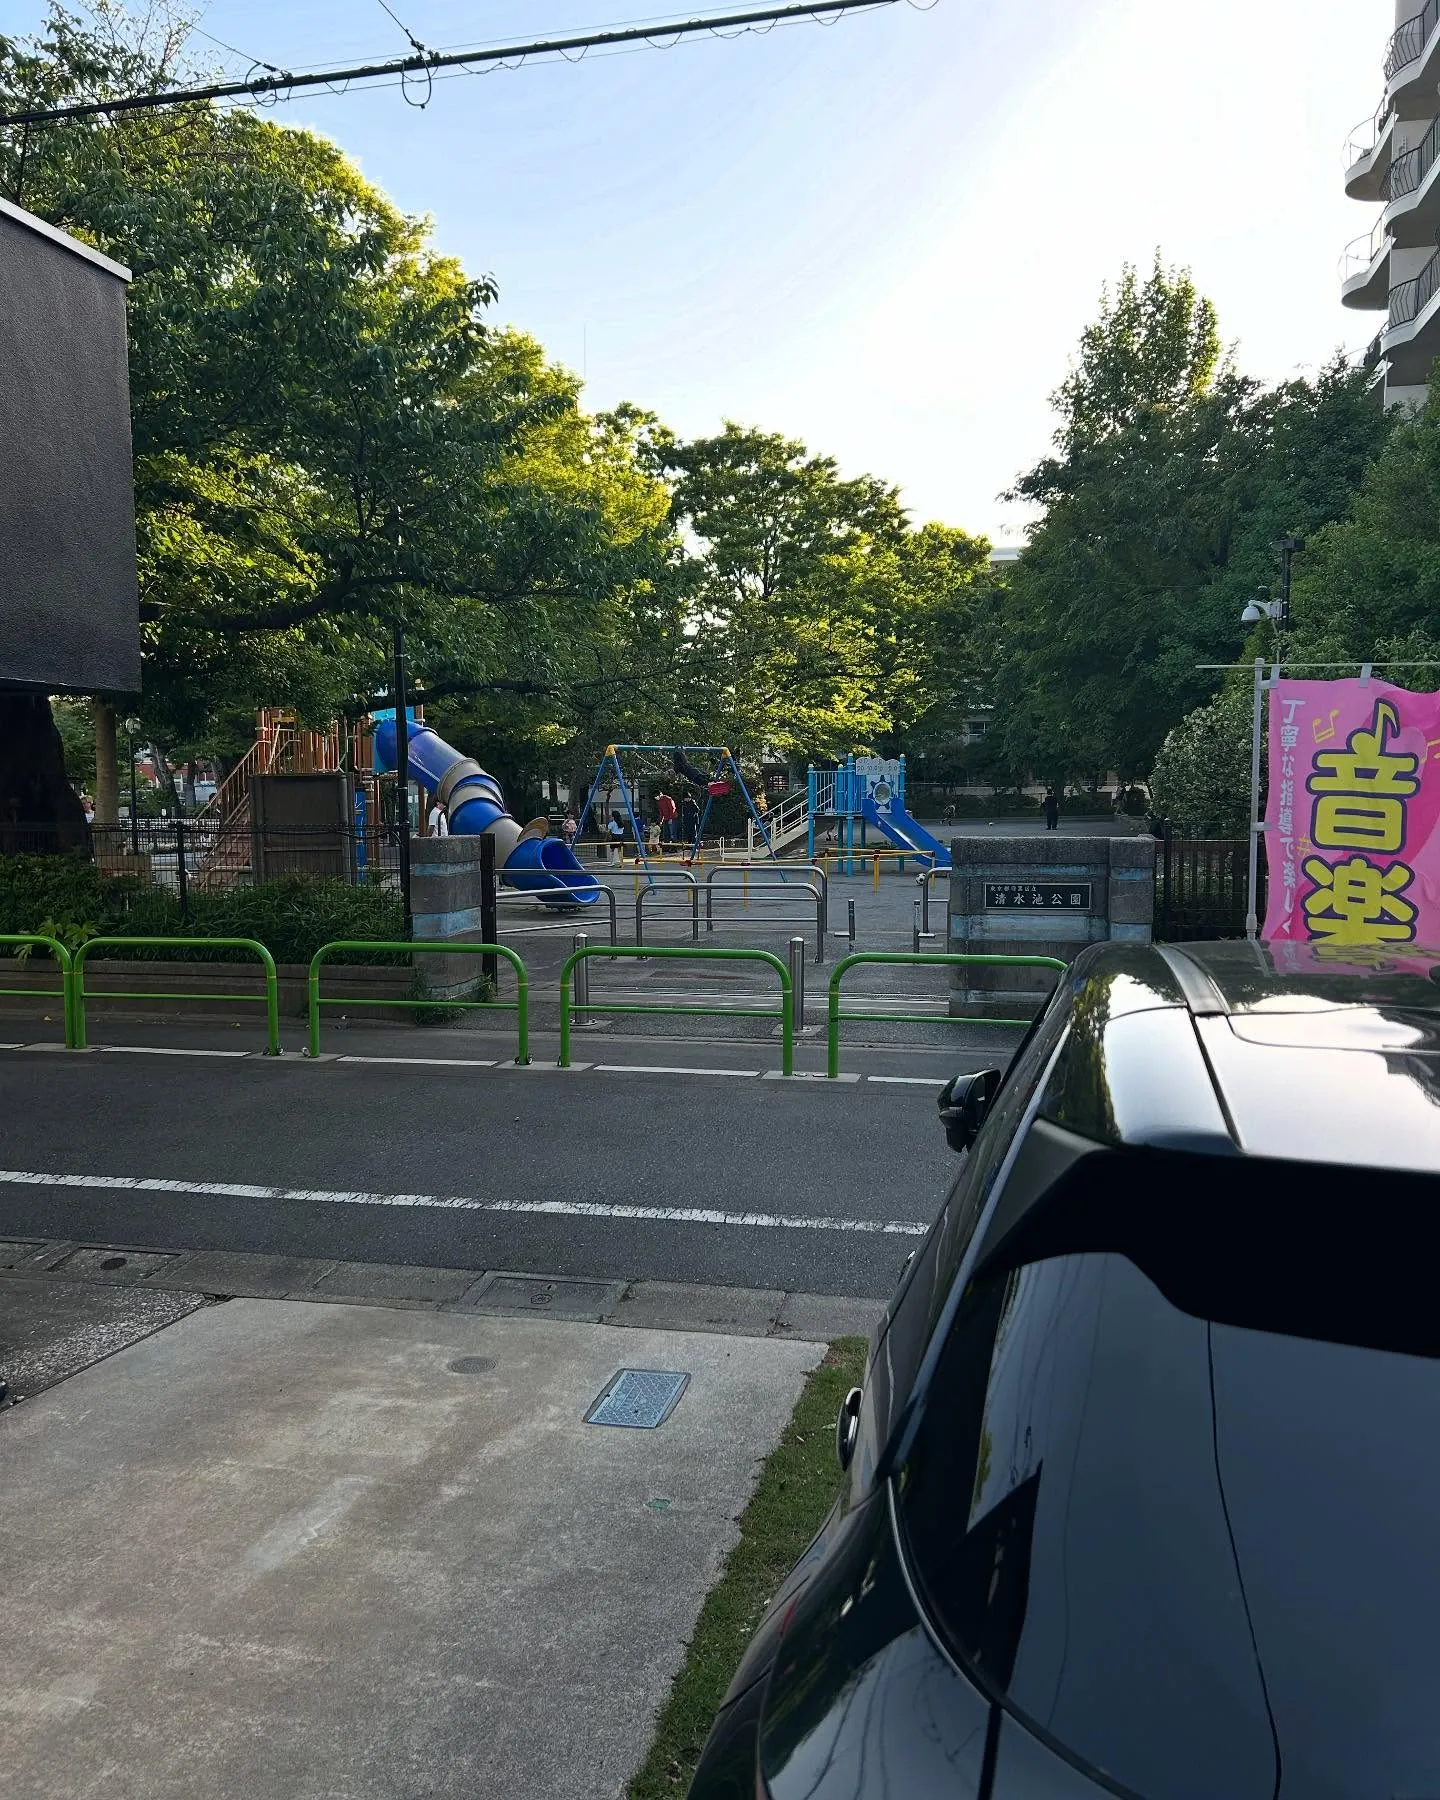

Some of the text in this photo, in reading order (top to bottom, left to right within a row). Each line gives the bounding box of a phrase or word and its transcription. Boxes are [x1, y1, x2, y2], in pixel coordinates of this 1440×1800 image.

[995, 892, 1081, 905] 清水池公園
[1278, 700, 1305, 935] 丁寧な指導で楽しく
[1301, 698, 1420, 943] 音楽
